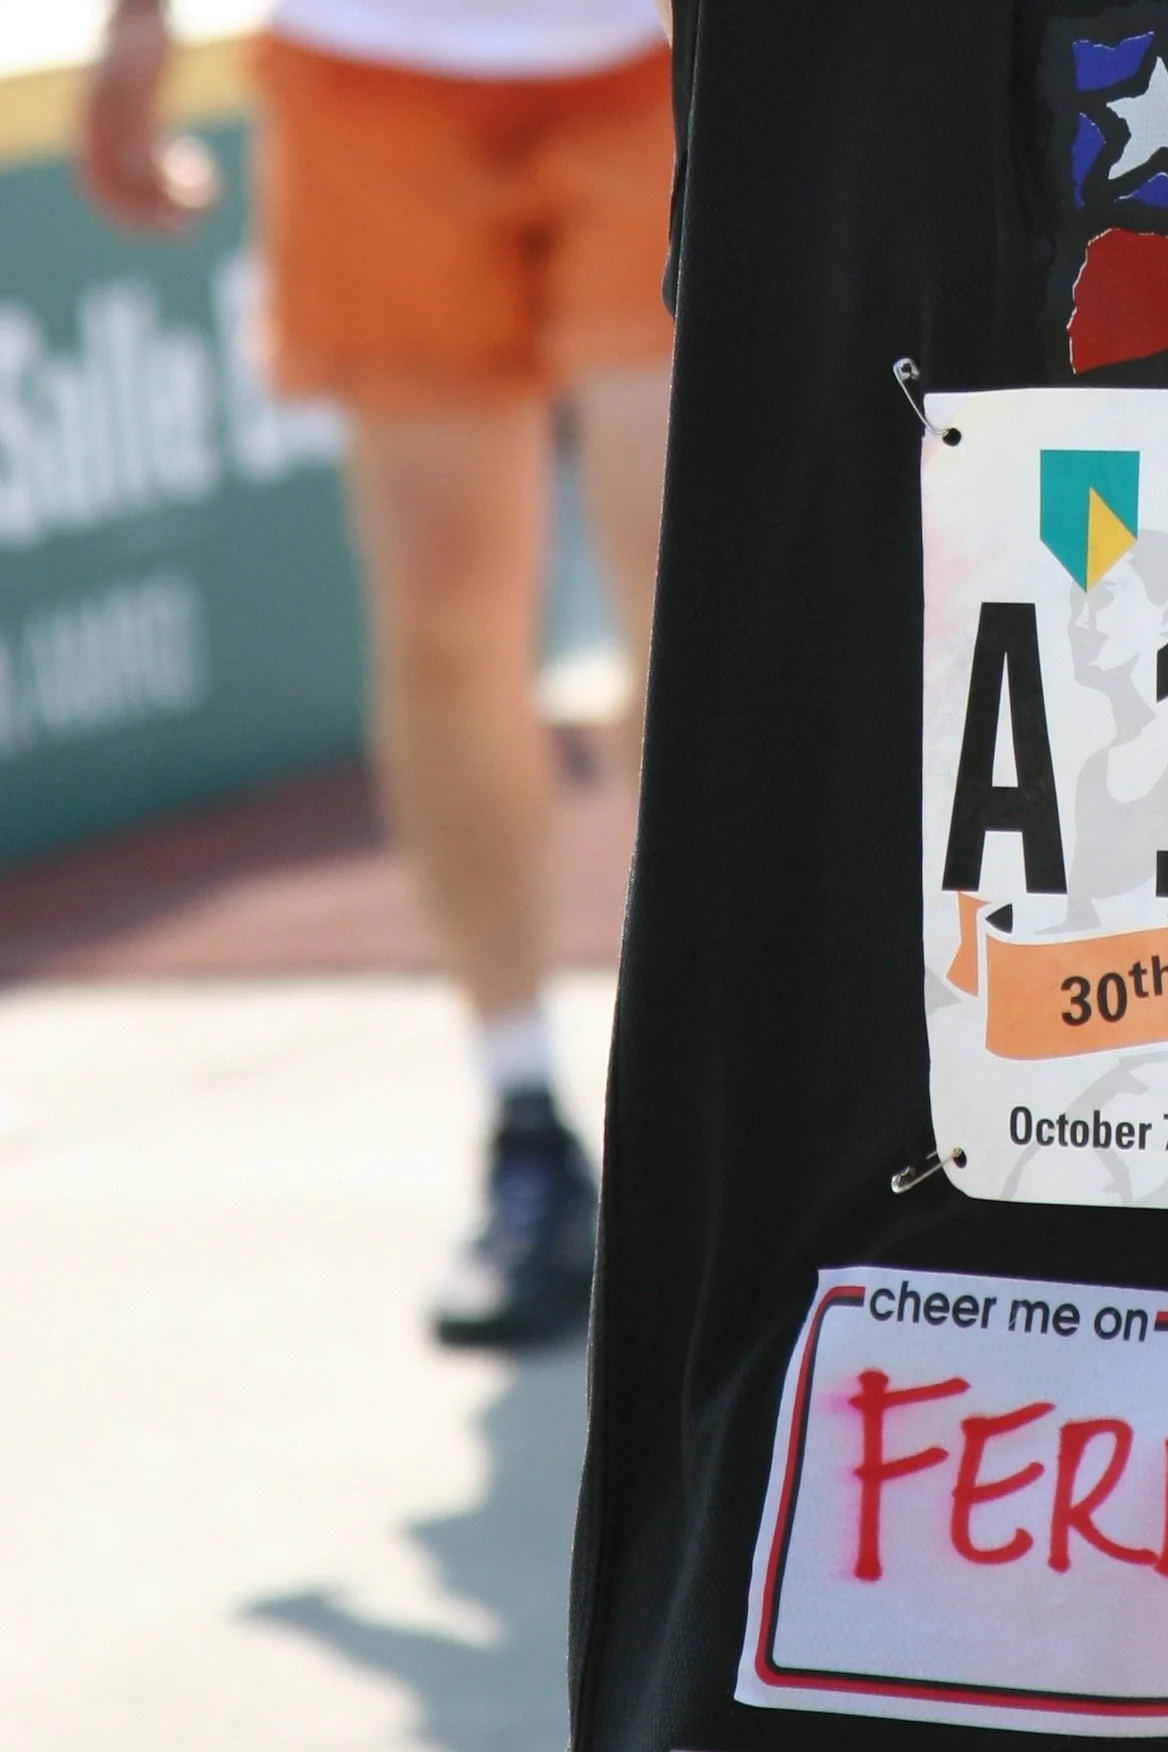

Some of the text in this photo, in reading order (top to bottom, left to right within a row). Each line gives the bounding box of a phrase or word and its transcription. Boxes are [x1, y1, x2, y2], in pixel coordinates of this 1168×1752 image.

[1009, 1105, 1152, 1149] October
[869, 1280, 1149, 1343] cheer me on
